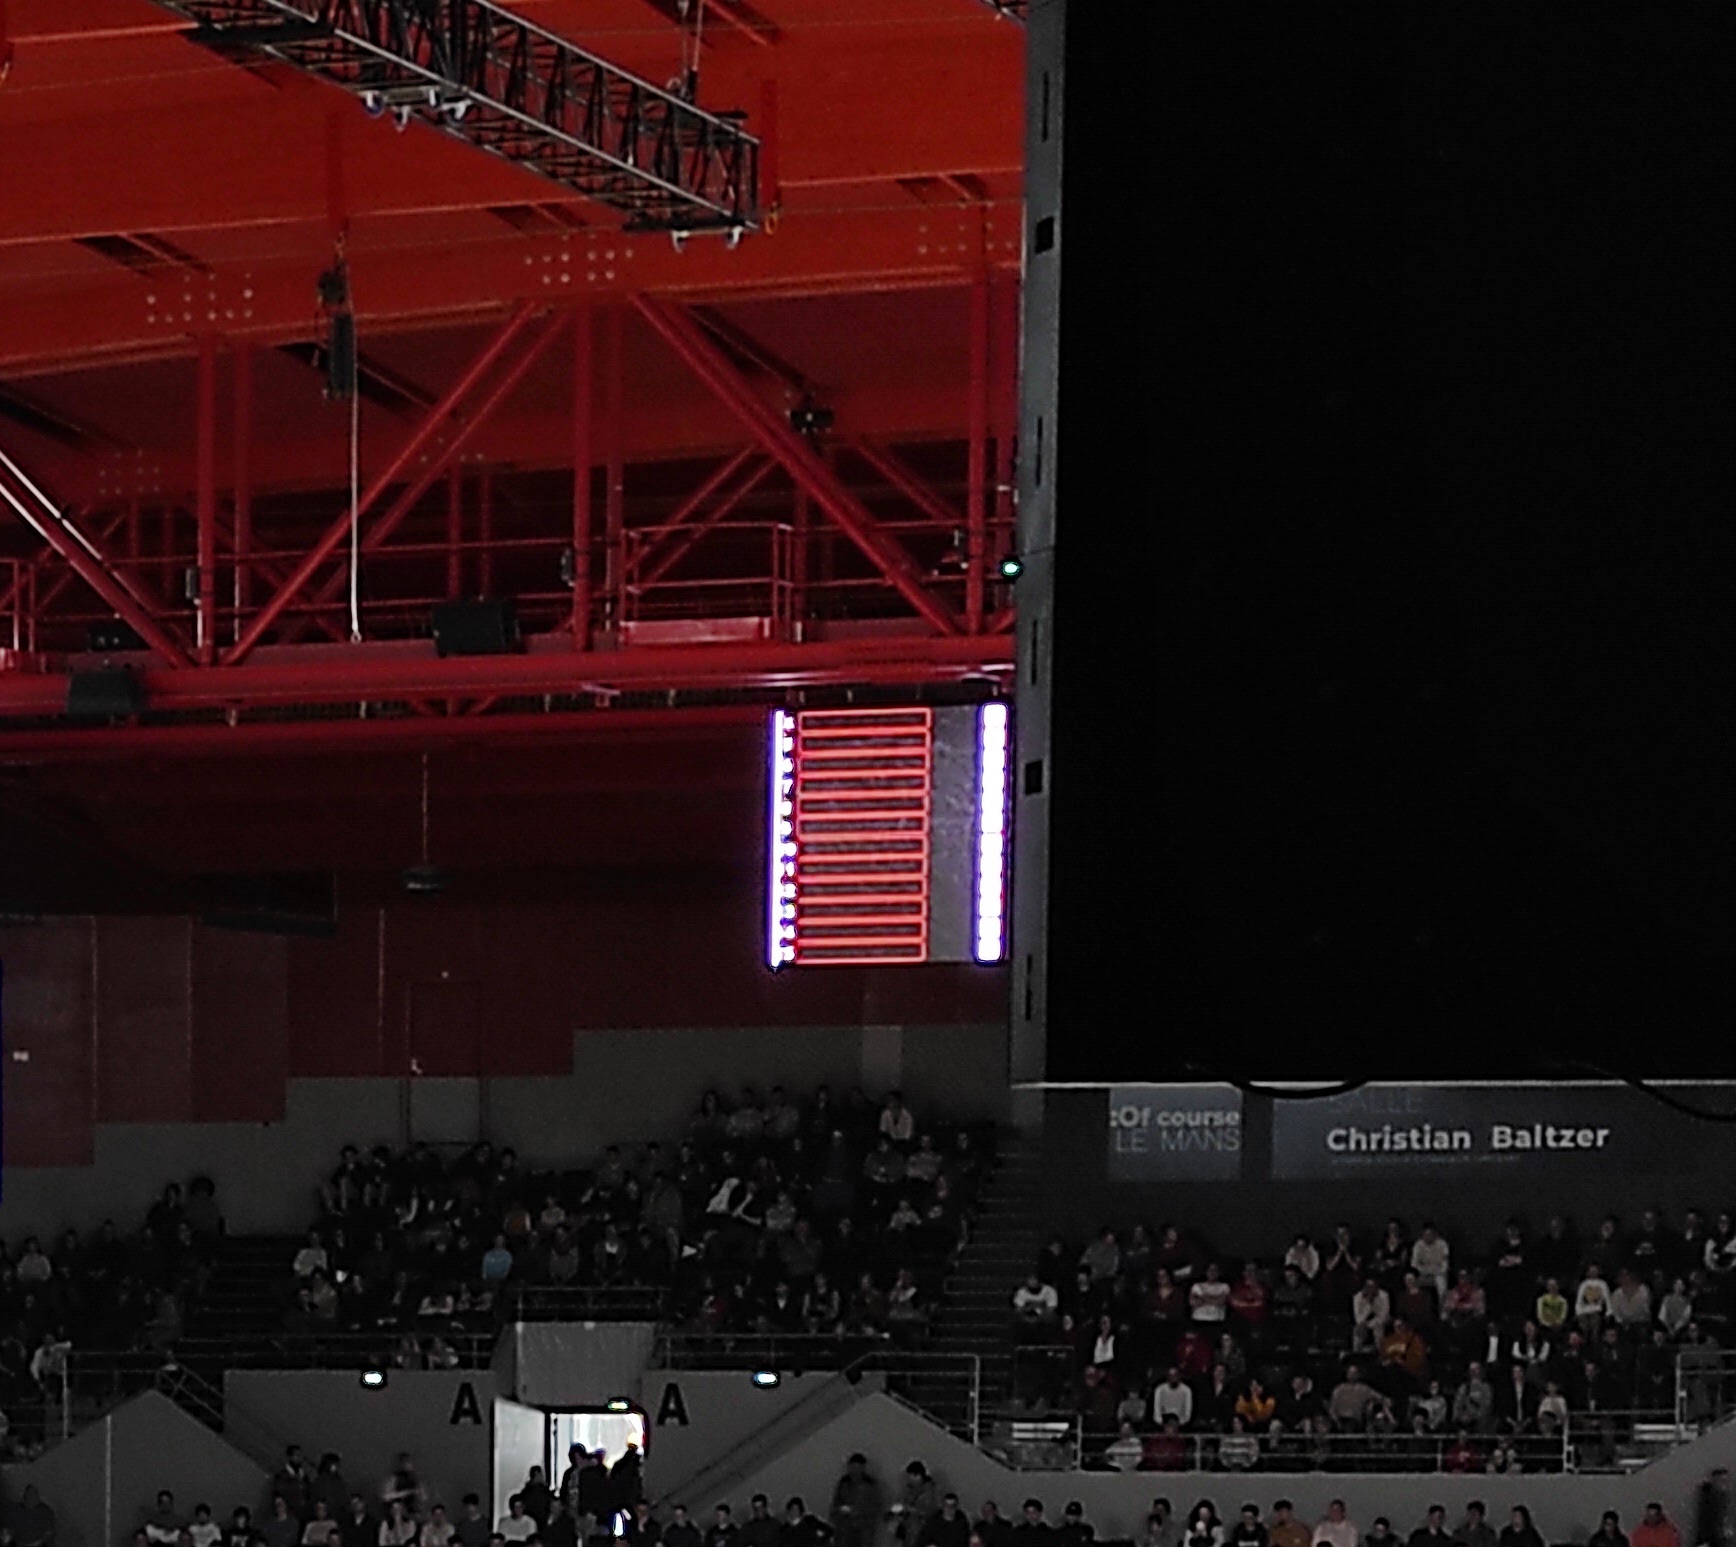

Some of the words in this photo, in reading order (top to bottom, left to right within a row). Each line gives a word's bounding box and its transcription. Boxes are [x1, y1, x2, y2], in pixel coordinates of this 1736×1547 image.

[1156, 1108, 1241, 1128] course
[1115, 1131, 1146, 1153] LE
[1162, 1131, 1241, 1153] MANS
[1326, 1125, 1472, 1153] Christian
[1491, 1124, 1610, 1150] Baltzer
[450, 1382, 483, 1425] A
[656, 1382, 690, 1426] A
